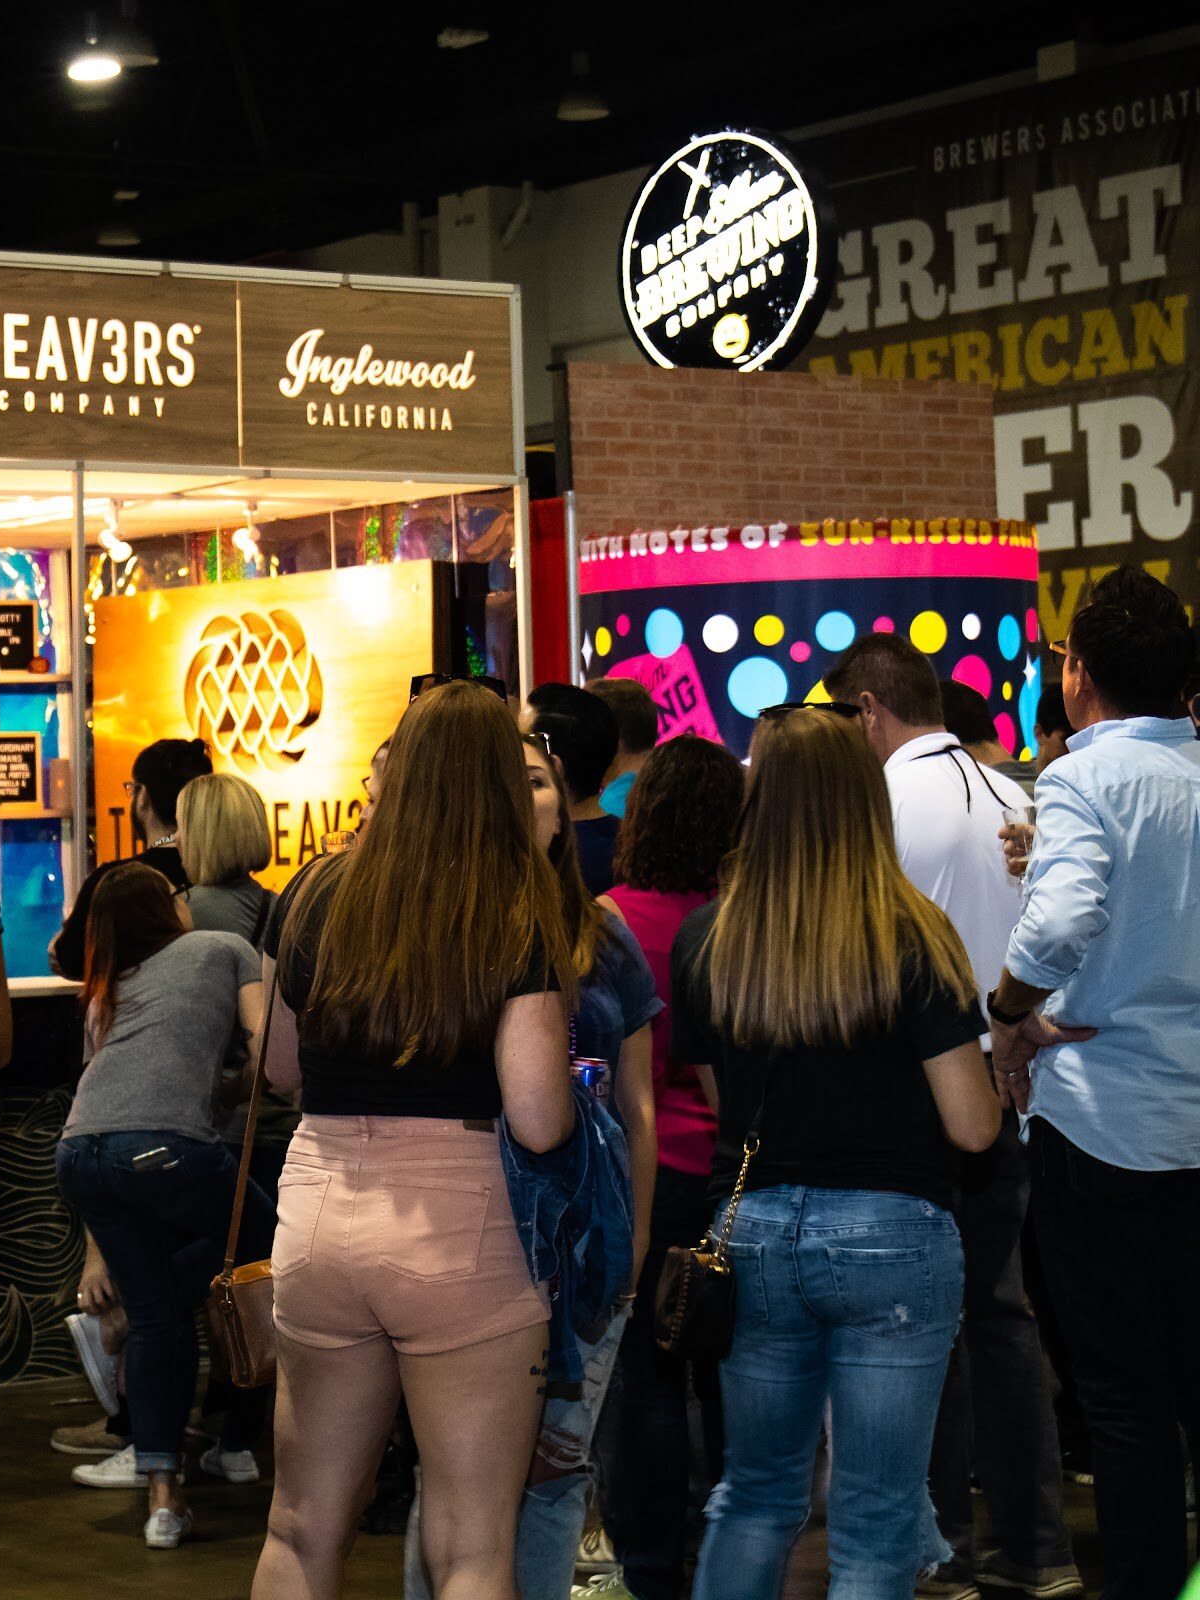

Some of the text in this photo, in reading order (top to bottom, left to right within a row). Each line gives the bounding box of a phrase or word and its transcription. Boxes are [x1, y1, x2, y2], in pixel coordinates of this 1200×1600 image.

[933, 124, 1046, 172] BREWERS
[636, 188, 806, 329] BREWING
[641, 215, 704, 275] DEEP
[814, 164, 1183, 338] GREAT
[665, 253, 785, 338] COMPANY
[278, 328, 478, 398] Inglewood
[306, 401, 453, 431] CALIFORNIA
[579, 536, 624, 563] WITH
[629, 525, 730, 556] NOTES
[740, 521, 788, 549] OF
[800, 517, 993, 547] SUN-KISSED
